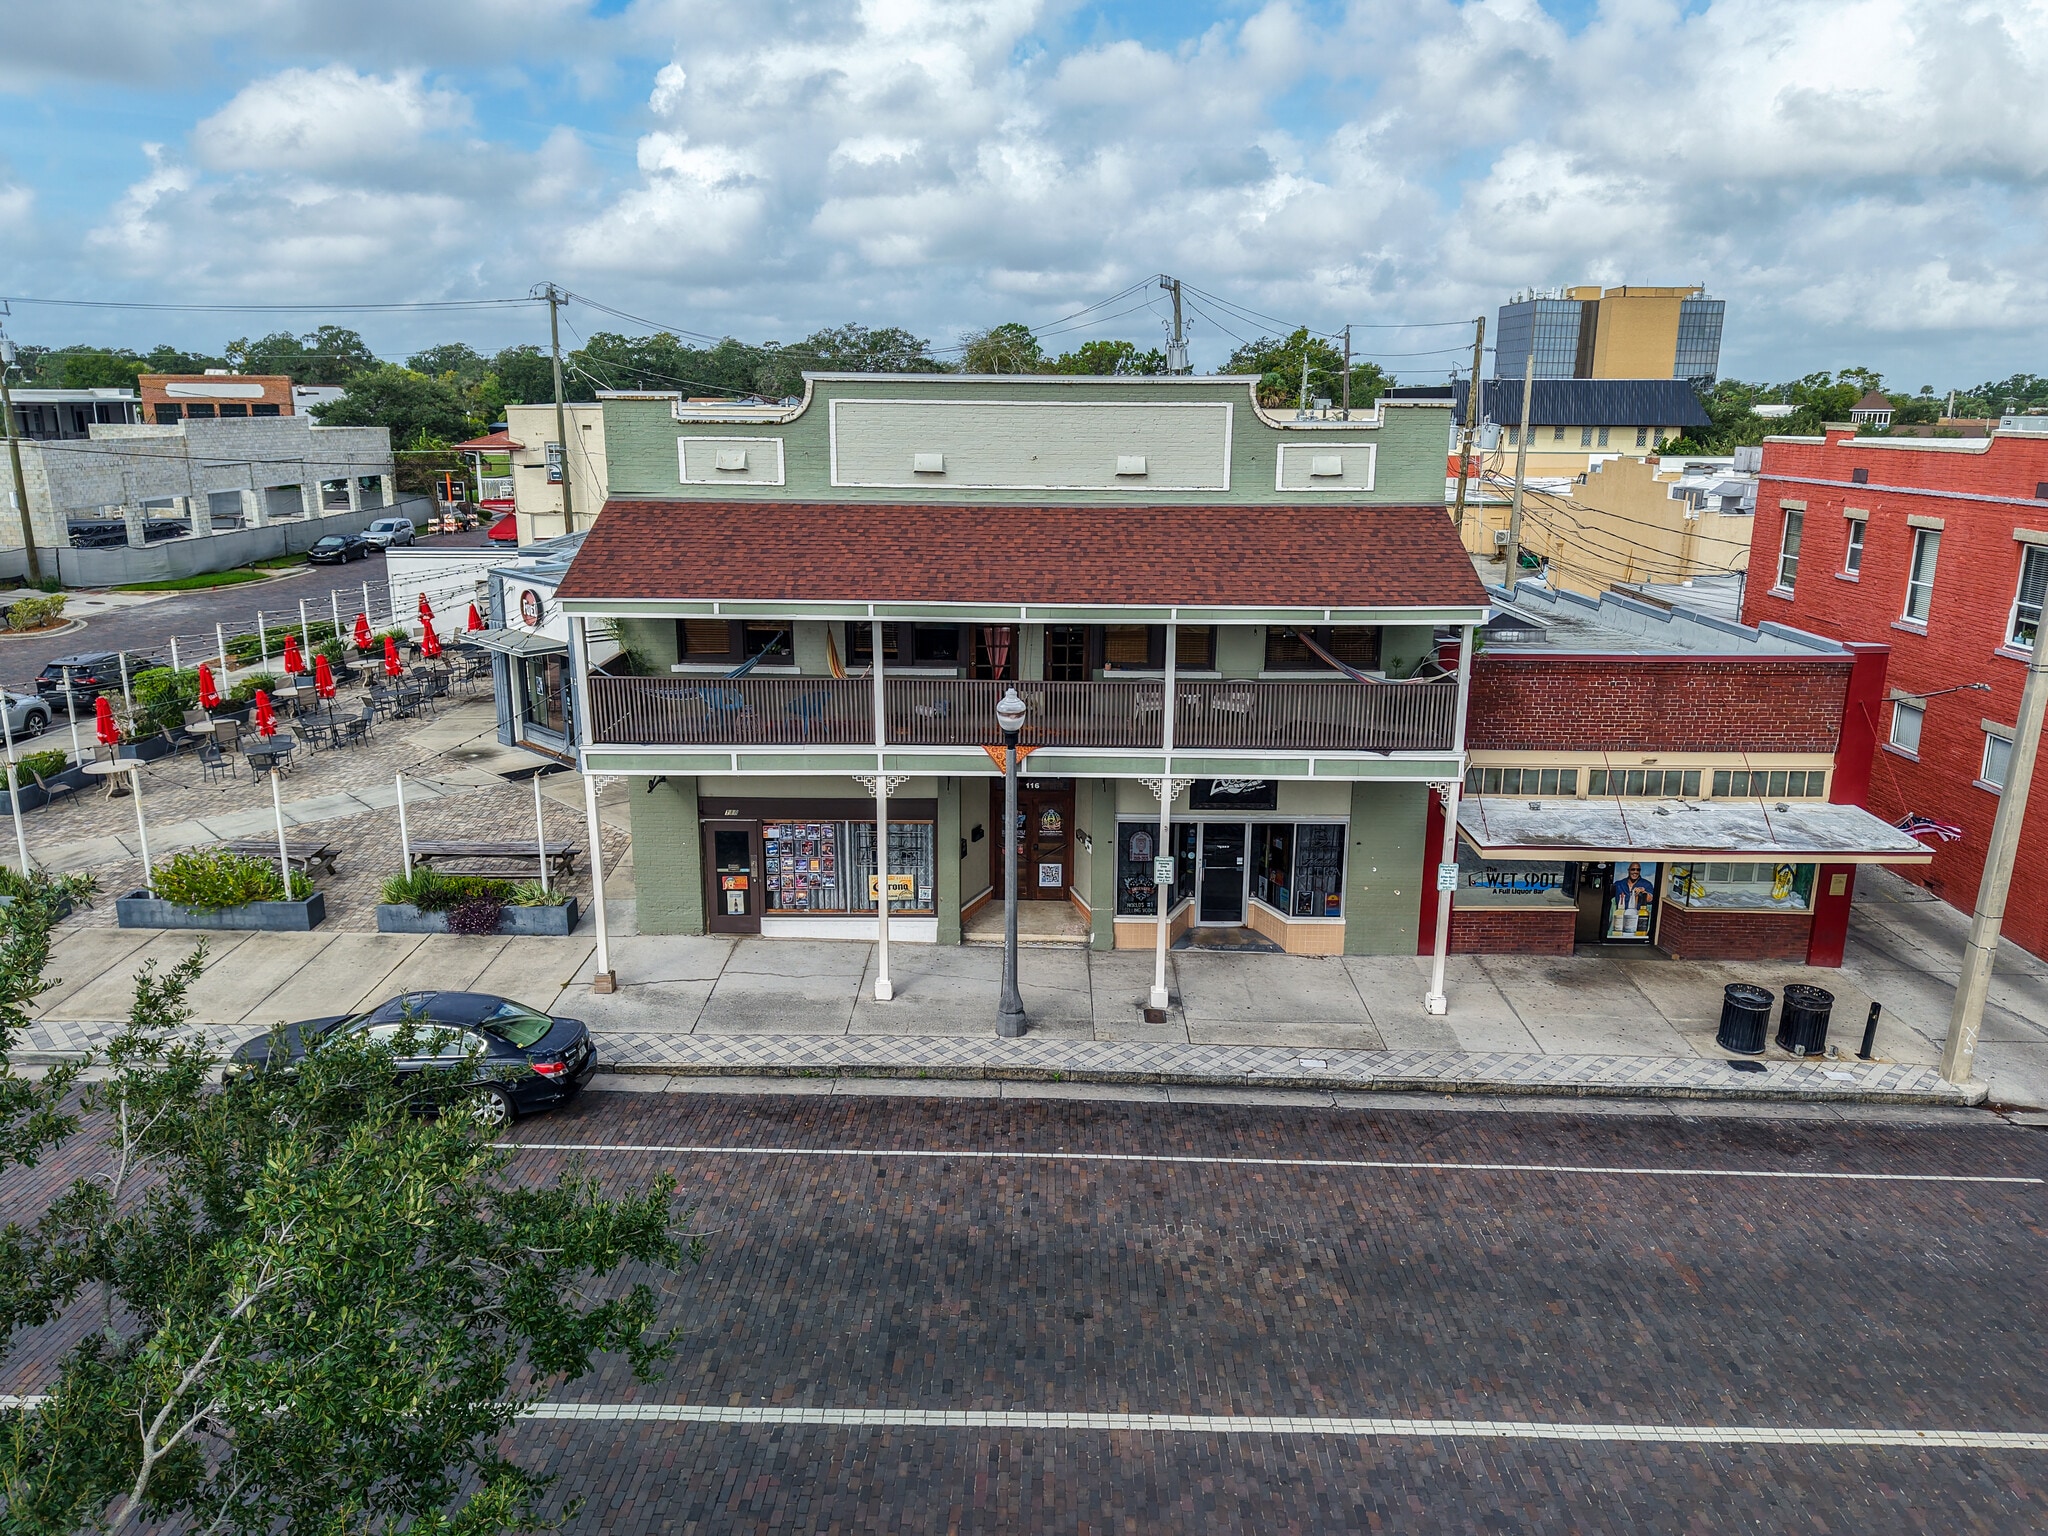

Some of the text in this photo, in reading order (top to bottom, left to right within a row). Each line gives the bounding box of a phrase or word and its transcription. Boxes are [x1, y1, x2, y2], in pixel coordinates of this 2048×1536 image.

[1486, 872, 1559, 888] WET SPOT
[872, 882, 909, 893] Crona
[1511, 888, 1532, 896] Liquor
